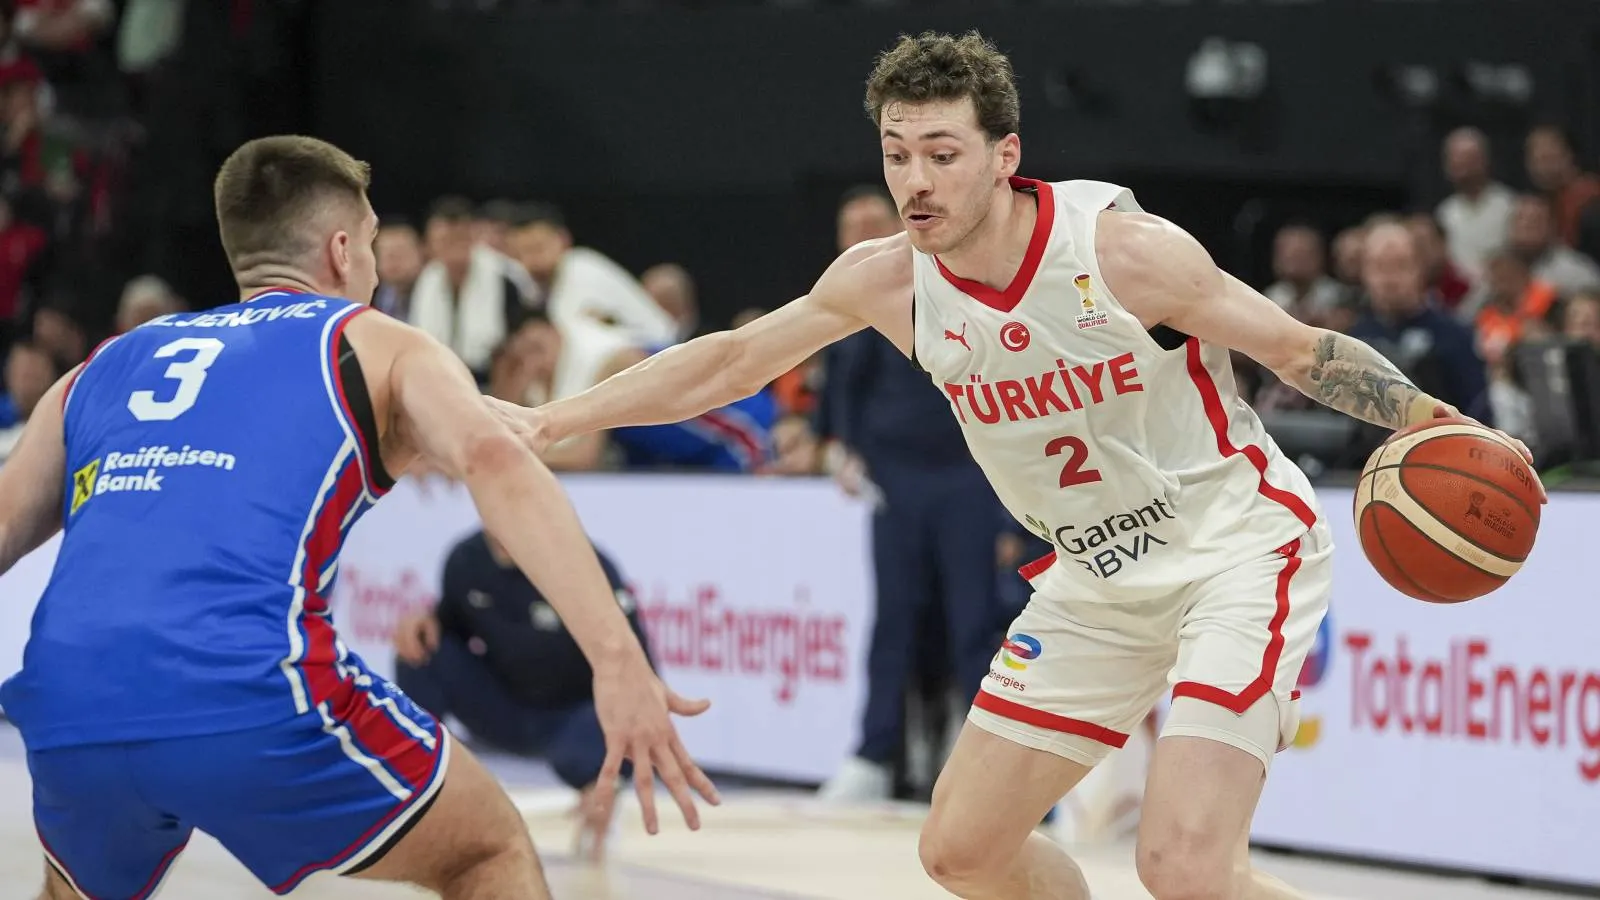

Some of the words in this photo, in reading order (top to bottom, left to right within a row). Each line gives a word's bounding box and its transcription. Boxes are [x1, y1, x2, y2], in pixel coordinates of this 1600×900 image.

[127, 337, 225, 421] 3
[944, 352, 1144, 425] TÜRKİYE
[94, 469, 164, 496] Bank
[103, 445, 236, 472] Raiffeisen
[1044, 435, 1103, 489] 2
[1055, 495, 1176, 556] Garant
